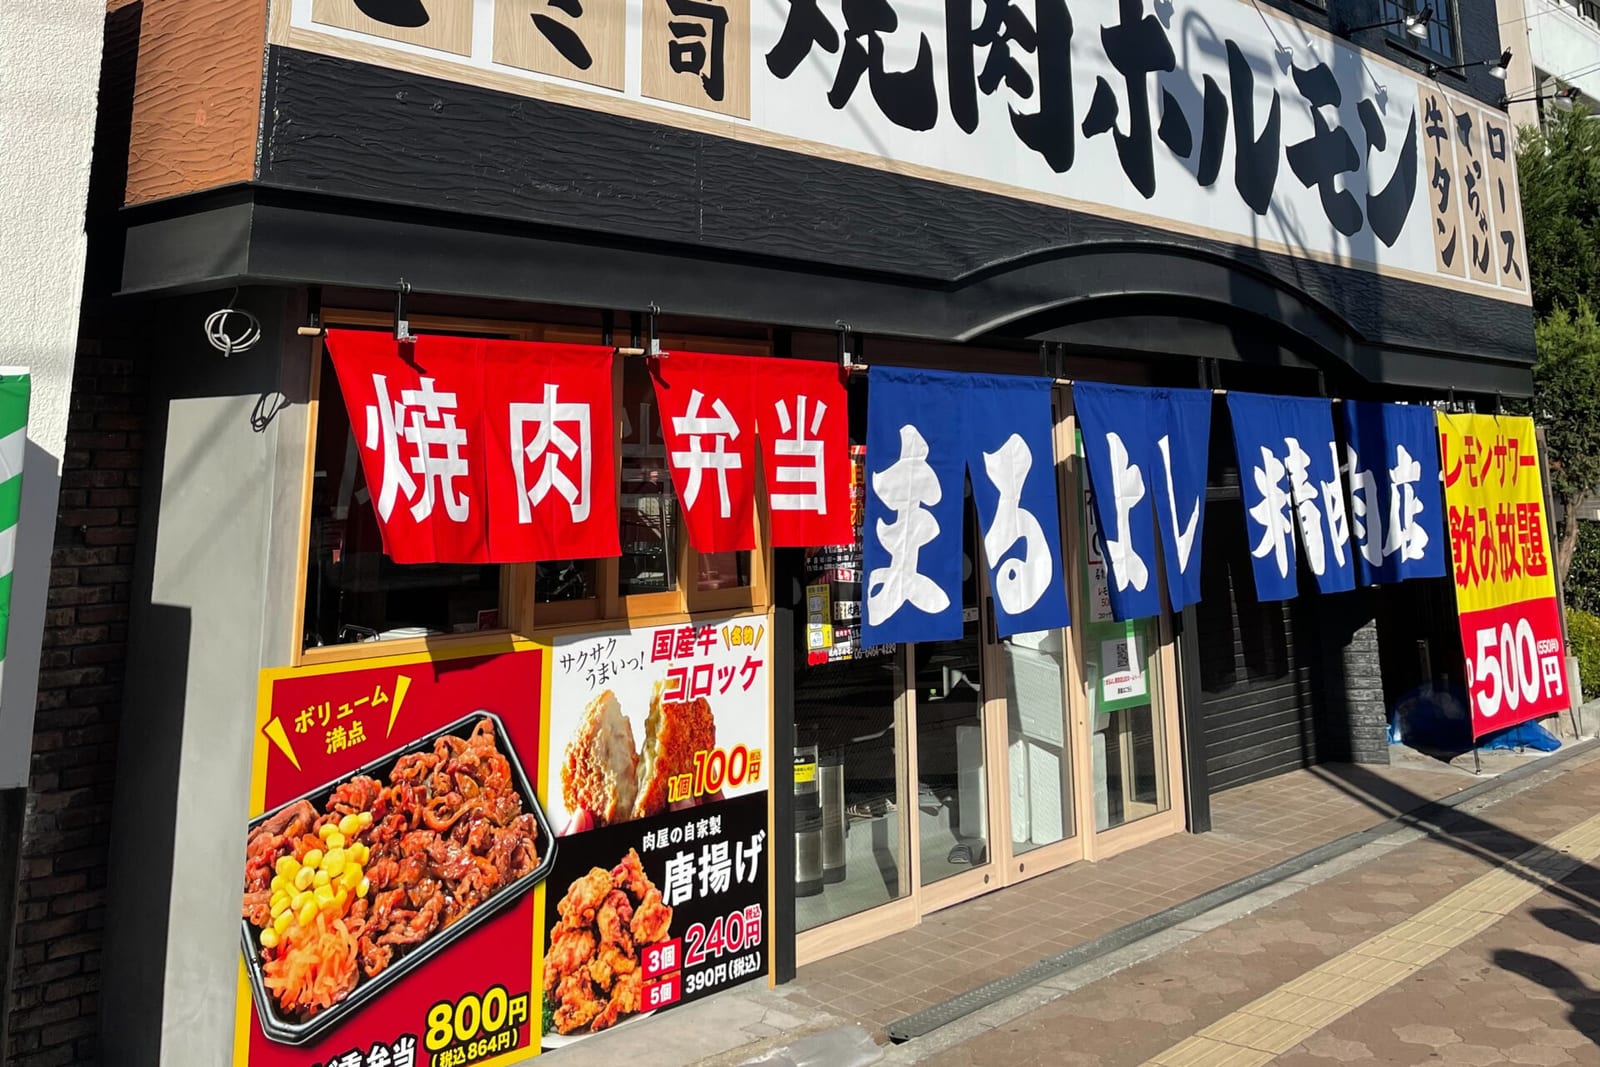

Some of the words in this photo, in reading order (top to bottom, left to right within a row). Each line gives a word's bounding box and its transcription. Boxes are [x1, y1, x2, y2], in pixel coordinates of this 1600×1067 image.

[1425, 95, 1457, 268] 牛タン
[1456, 111, 1490, 274] てっちゃん
[1486, 121, 1522, 282] ロース
[1441, 433, 1536, 488] レモンサワー
[1449, 502, 1548, 590] 飲み放題
[560, 638, 617, 674] サクサク
[651, 624, 717, 663] 国産牛
[663, 655, 763, 701] コロッケ
[293, 685, 389, 735] ボリューム
[325, 719, 367, 755] 満点
[642, 815, 722, 852] 肉屋の自家製
[662, 829, 766, 907] 唐揚げ
[648, 944, 676, 973] 3個
[425, 987, 528, 1050] 800円
[650, 982, 672, 1005] 5個
